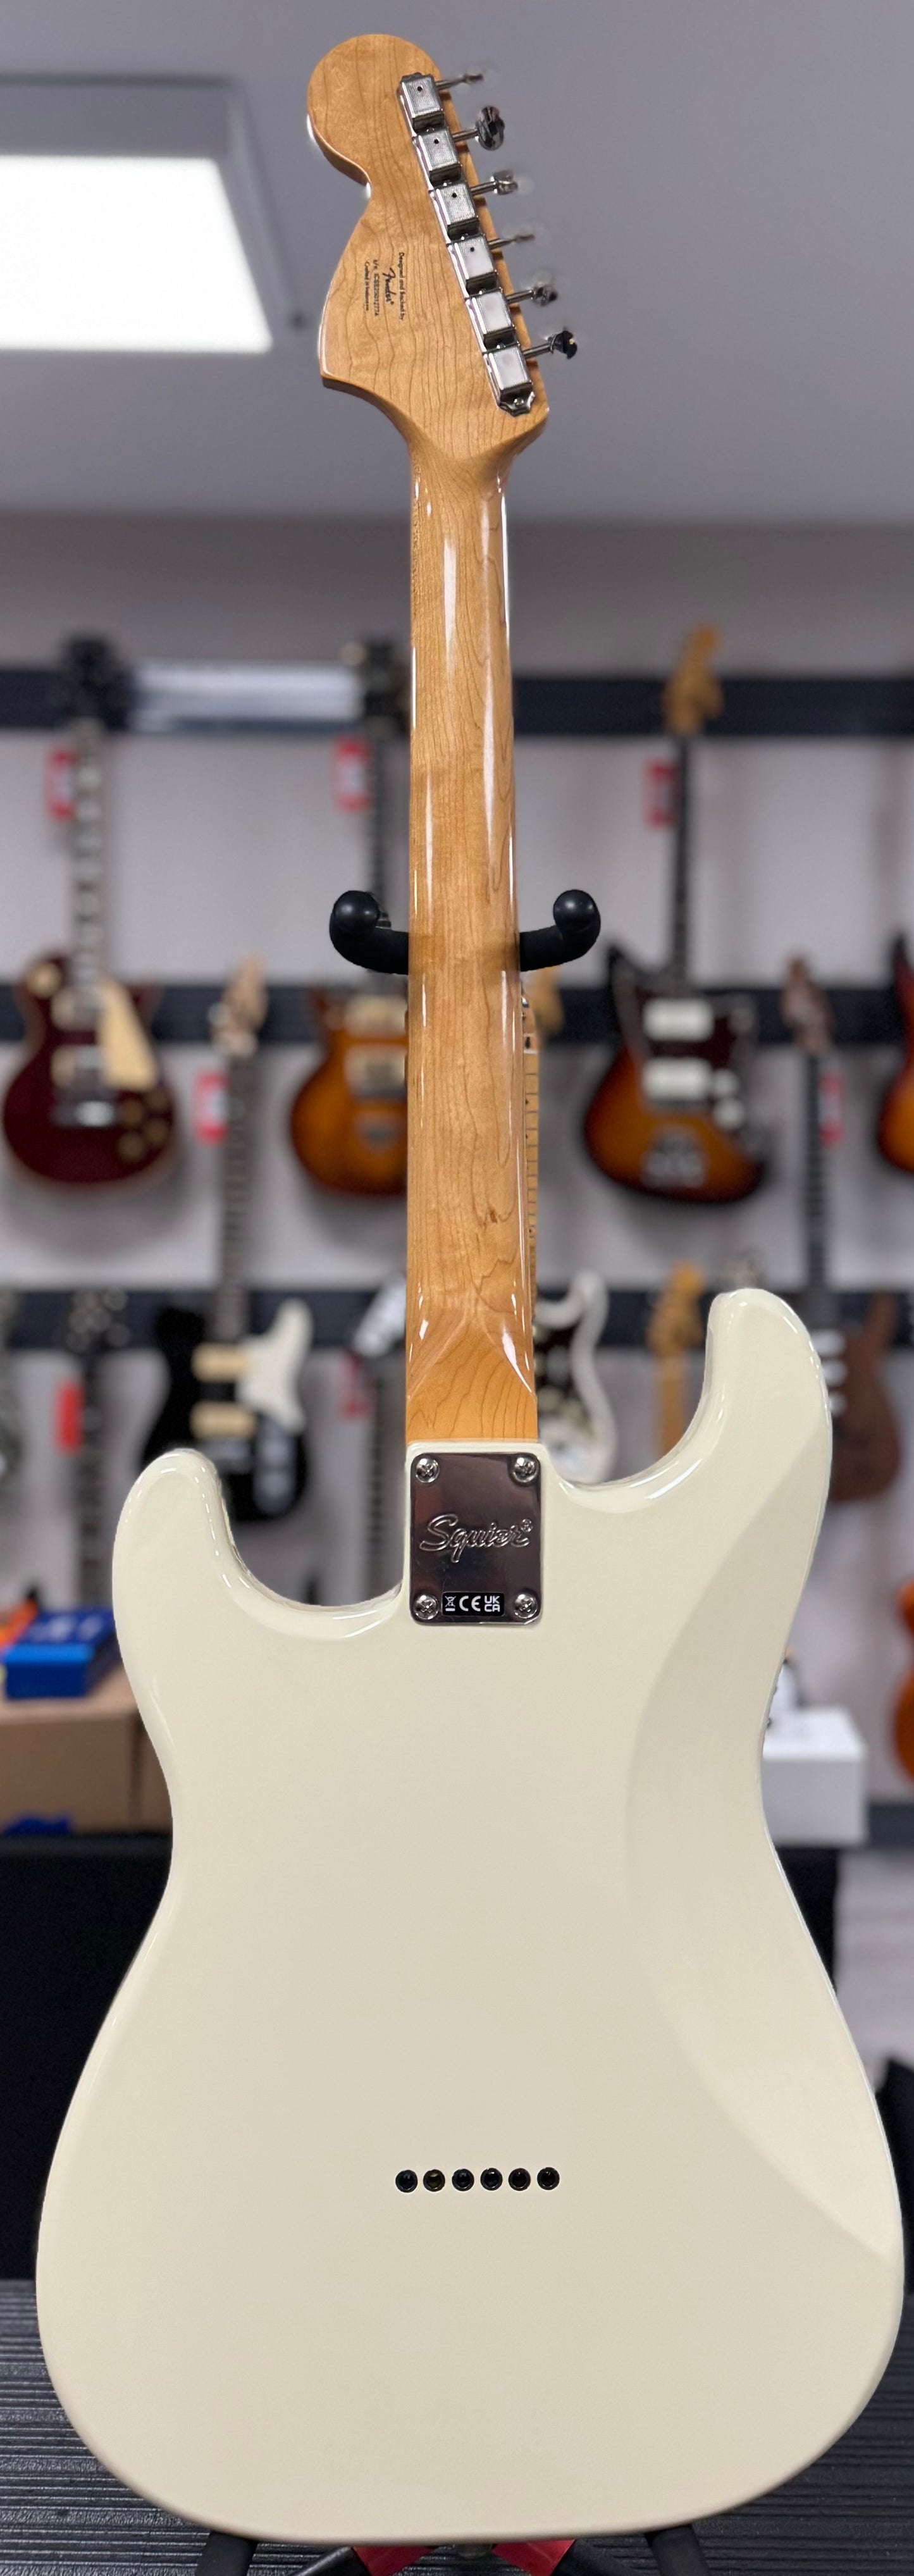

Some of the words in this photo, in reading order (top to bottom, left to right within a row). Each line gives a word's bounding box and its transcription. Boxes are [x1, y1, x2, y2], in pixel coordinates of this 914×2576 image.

[397, 252, 405, 278] Designed
[459, 1595, 481, 1612] CE
[484, 1595, 500, 1604] UK
[484, 1604, 500, 1613] CA
